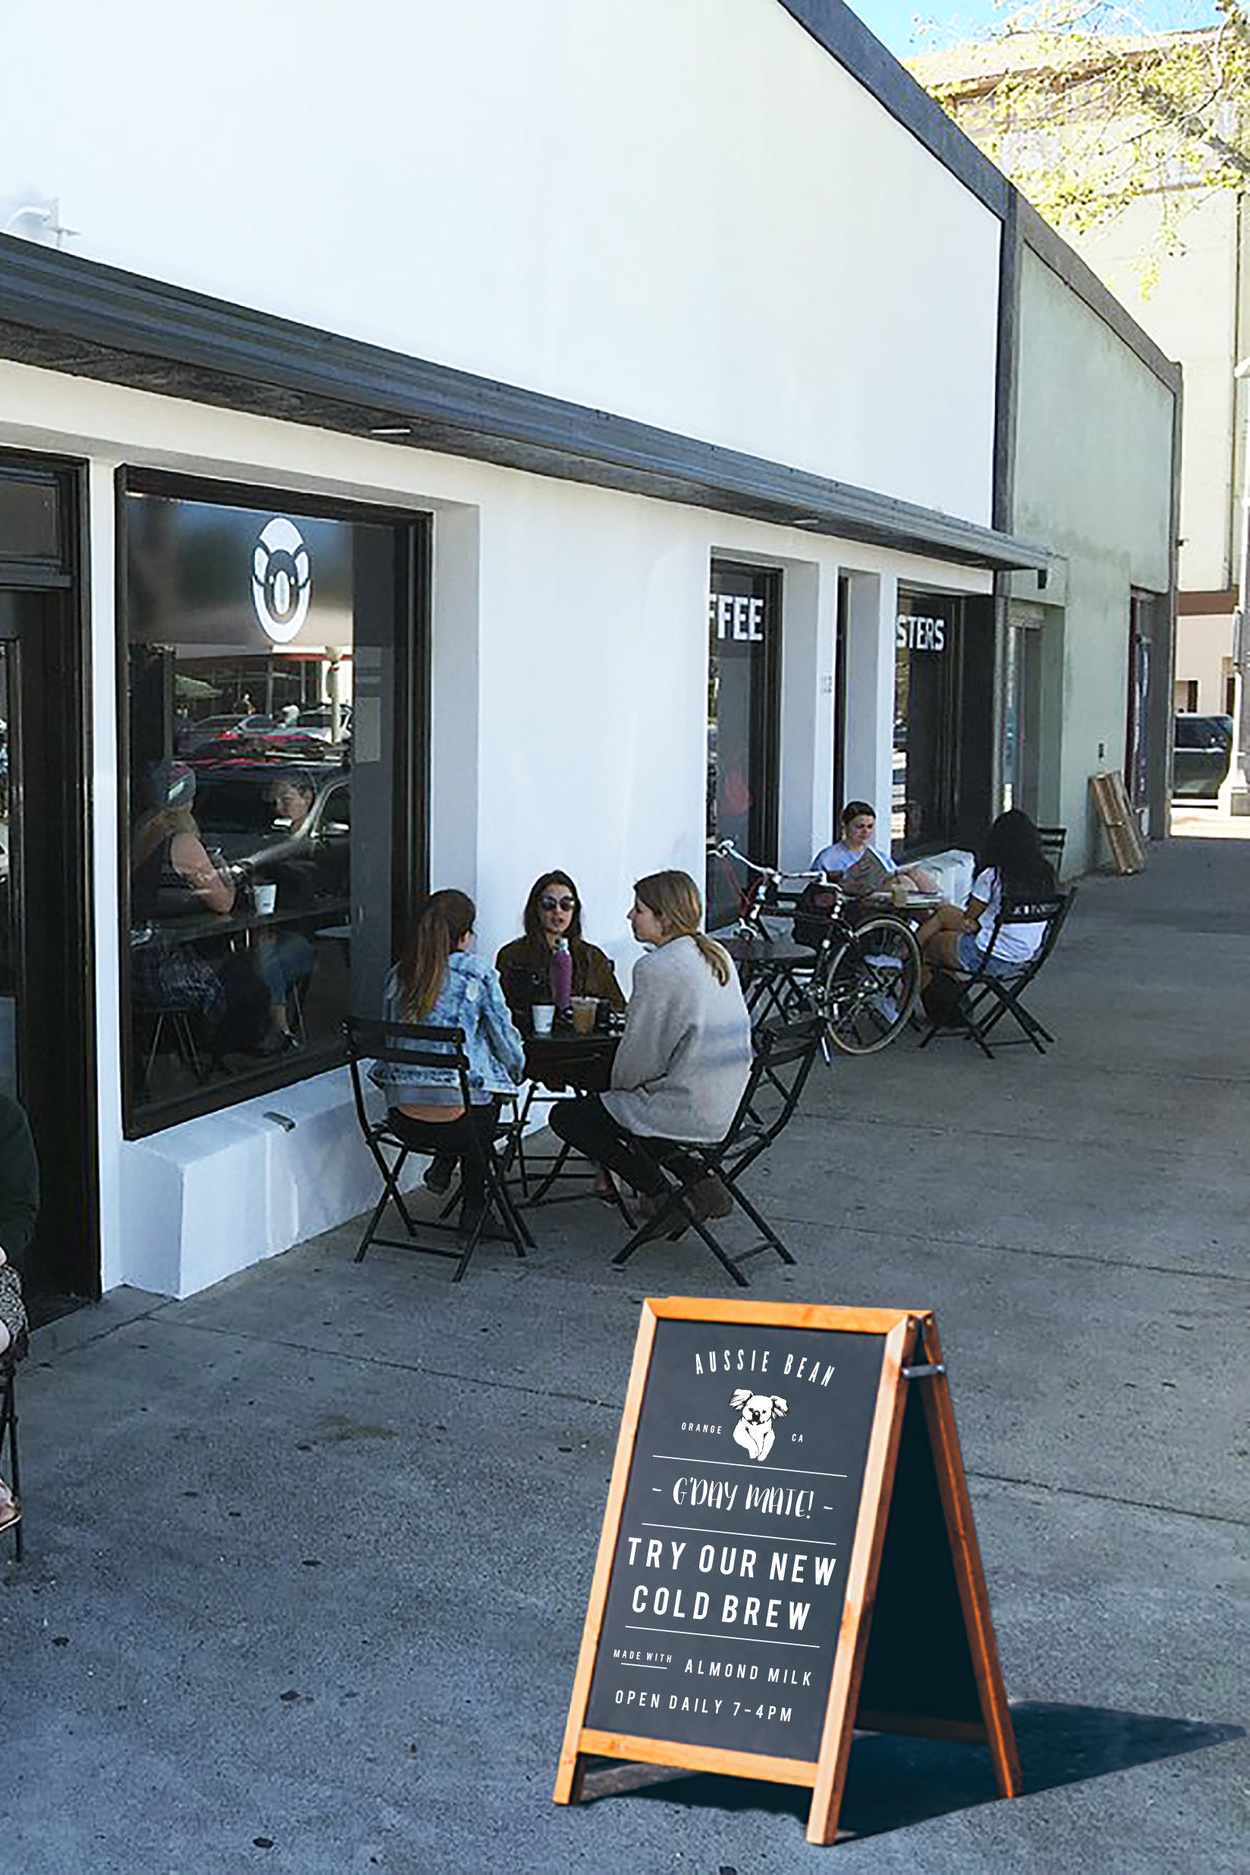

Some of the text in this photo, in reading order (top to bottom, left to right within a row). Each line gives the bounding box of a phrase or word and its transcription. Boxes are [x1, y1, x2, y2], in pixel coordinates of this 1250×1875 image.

[696, 1349, 835, 1386] AUSSIE BEAN
[682, 1422, 803, 1442] ORANGE CA
[673, 1477, 814, 1519] G'DAY MATE!
[628, 1537, 836, 1585] TRY OUR NEW
[632, 1585, 810, 1630] COLD BREW
[614, 1649, 811, 1686] MADE WITH ALMOND MILK
[615, 1690, 792, 1722] OPEN DAILY 7-4PM
